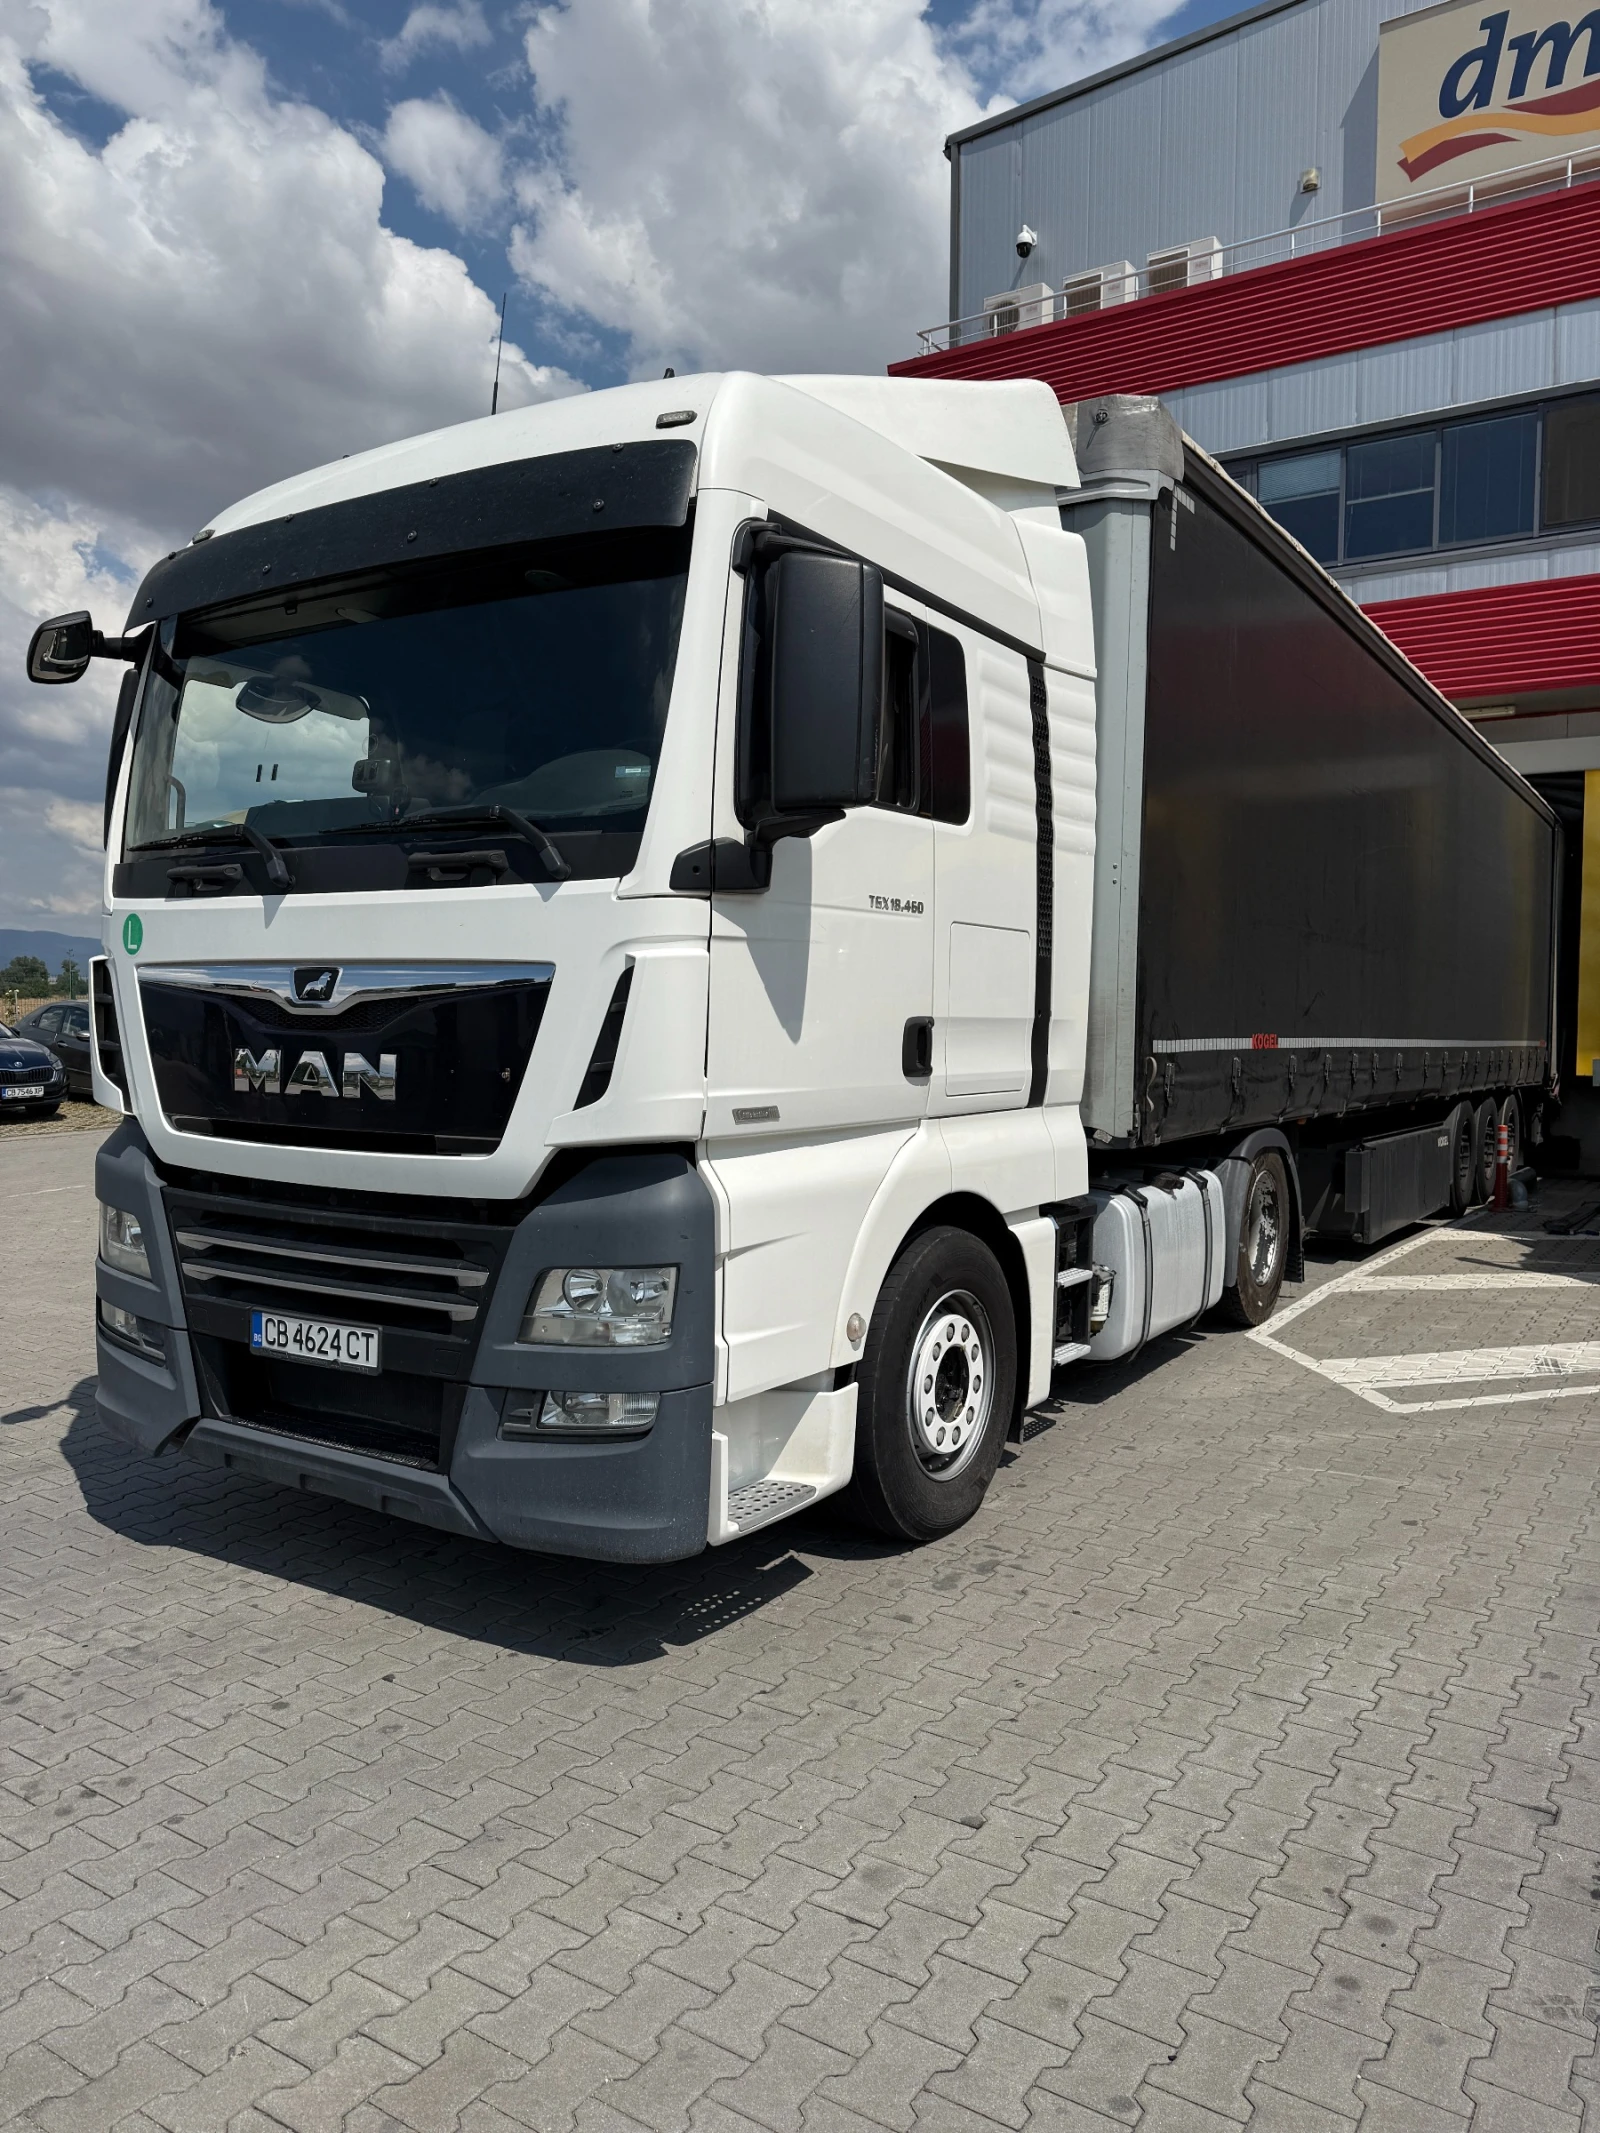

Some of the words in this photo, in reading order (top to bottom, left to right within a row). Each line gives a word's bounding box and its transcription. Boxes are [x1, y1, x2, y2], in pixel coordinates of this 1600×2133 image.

[868, 894, 889, 910] TGX
[127, 920, 138, 950] L
[234, 1048, 397, 1101] MAN
[264, 1317, 289, 1348] CB
[292, 1323, 341, 1357] 4624
[346, 1331, 375, 1362] CT
